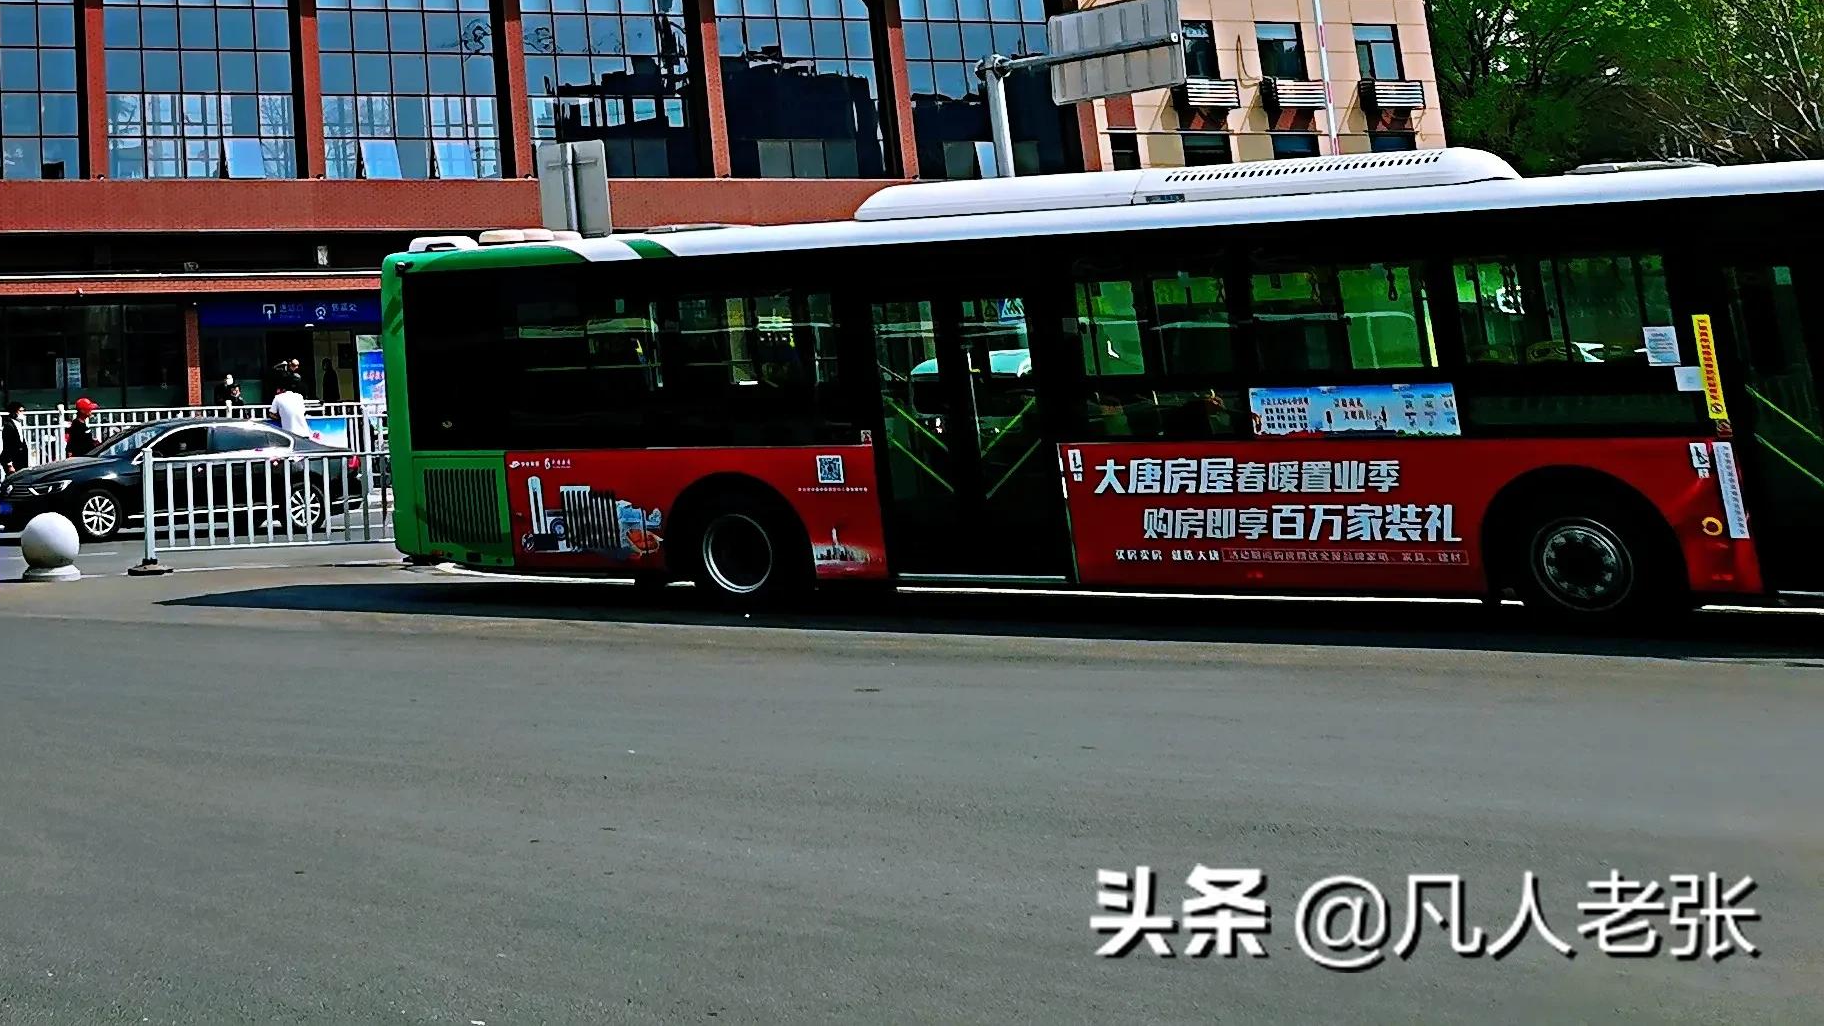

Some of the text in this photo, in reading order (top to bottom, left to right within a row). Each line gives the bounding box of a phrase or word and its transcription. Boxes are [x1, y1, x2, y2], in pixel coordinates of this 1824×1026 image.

[1094, 457, 1400, 494] 大唐房屋春暖置业季
[1143, 504, 1463, 543] 购房即享百万家装礼
